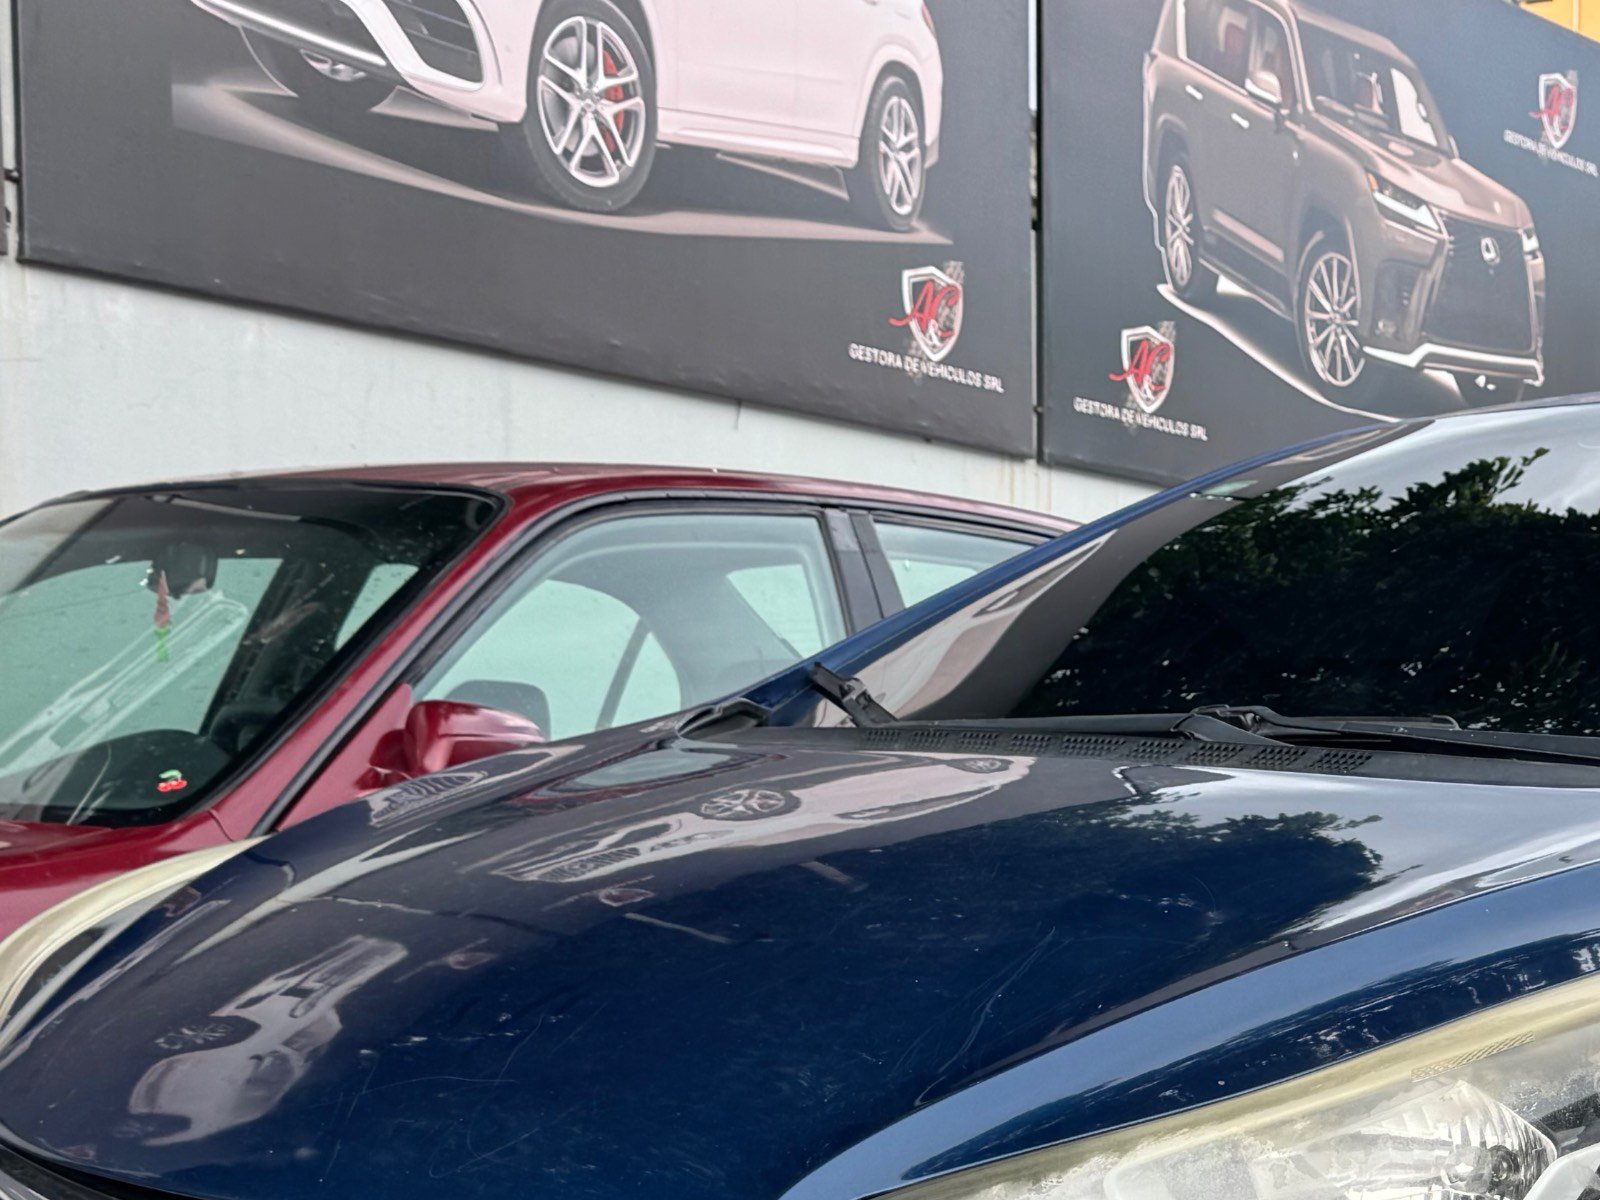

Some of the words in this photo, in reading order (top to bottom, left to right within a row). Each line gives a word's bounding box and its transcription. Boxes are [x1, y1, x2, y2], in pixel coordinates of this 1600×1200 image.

[848, 342, 903, 368] GESTORA
[903, 356, 919, 372] DE
[983, 373, 1005, 393] SRL
